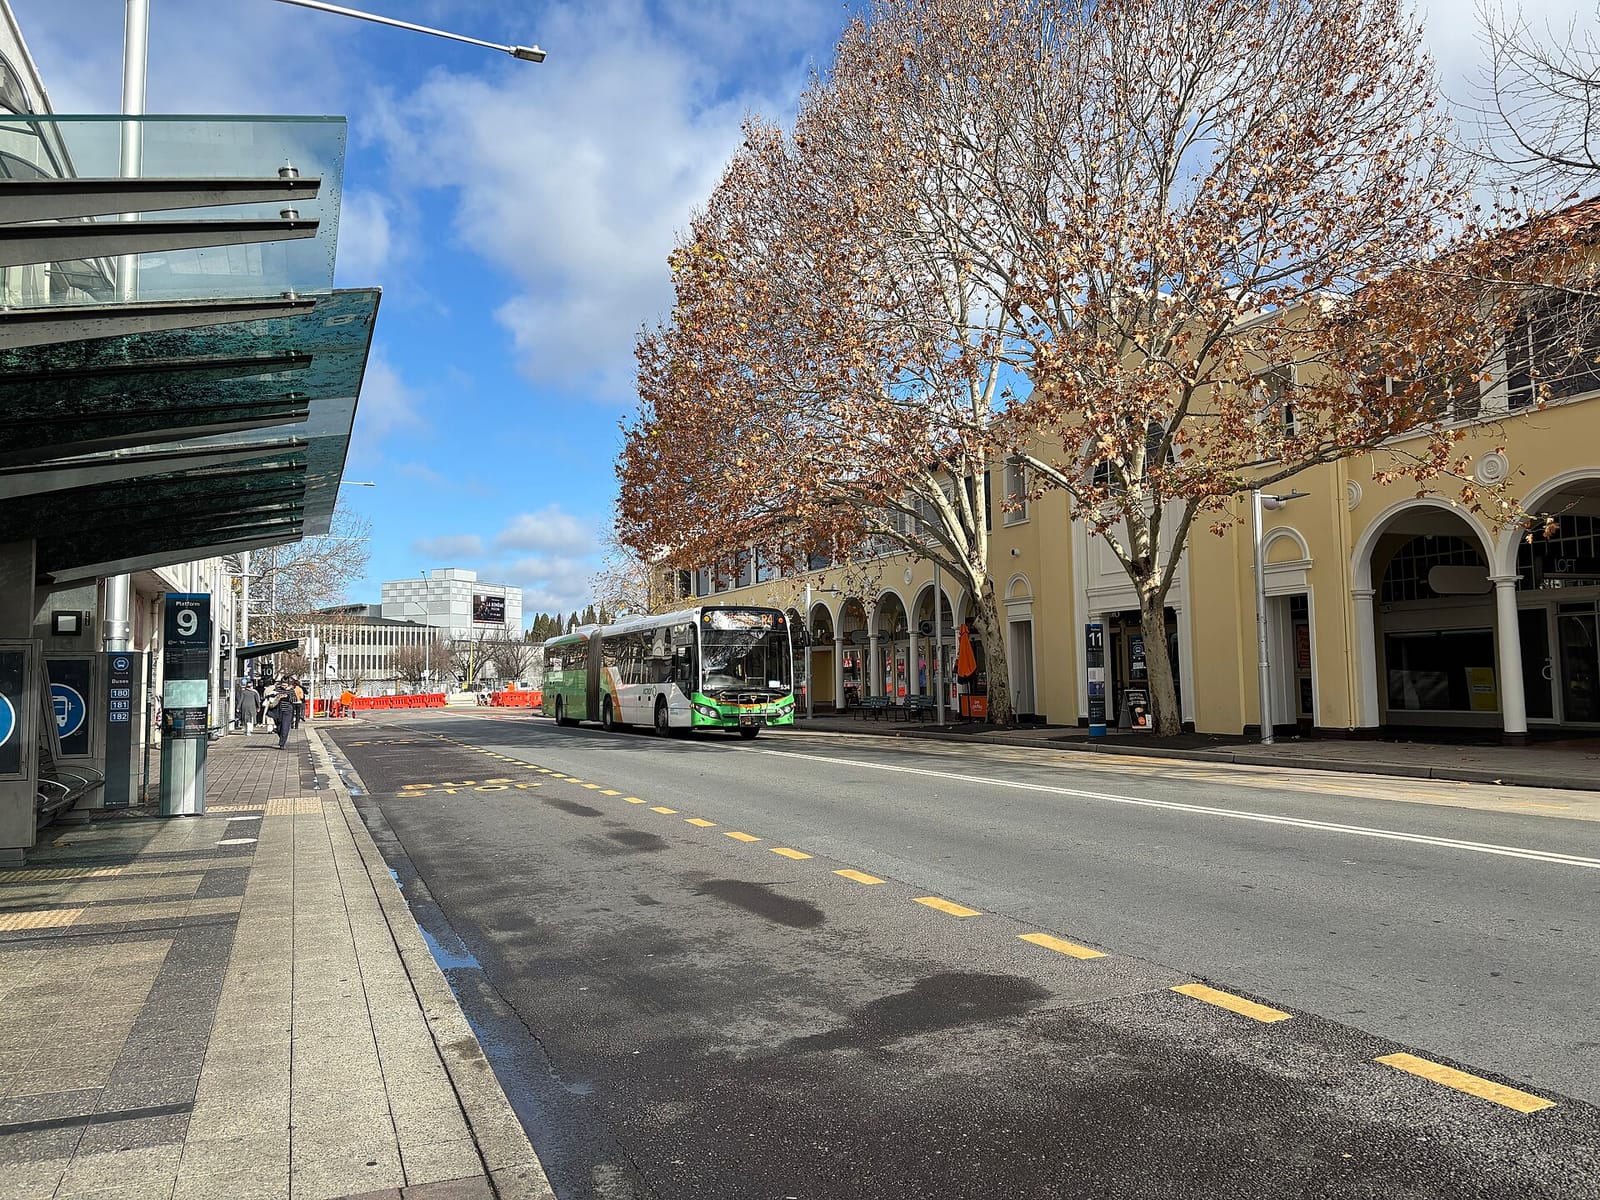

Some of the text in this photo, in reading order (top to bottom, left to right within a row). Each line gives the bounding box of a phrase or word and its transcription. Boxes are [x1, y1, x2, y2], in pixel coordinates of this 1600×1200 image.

[176, 609, 198, 636] 9
[760, 614, 774, 626] R4
[1088, 632, 1102, 647] 11
[262, 668, 273, 676] 10
